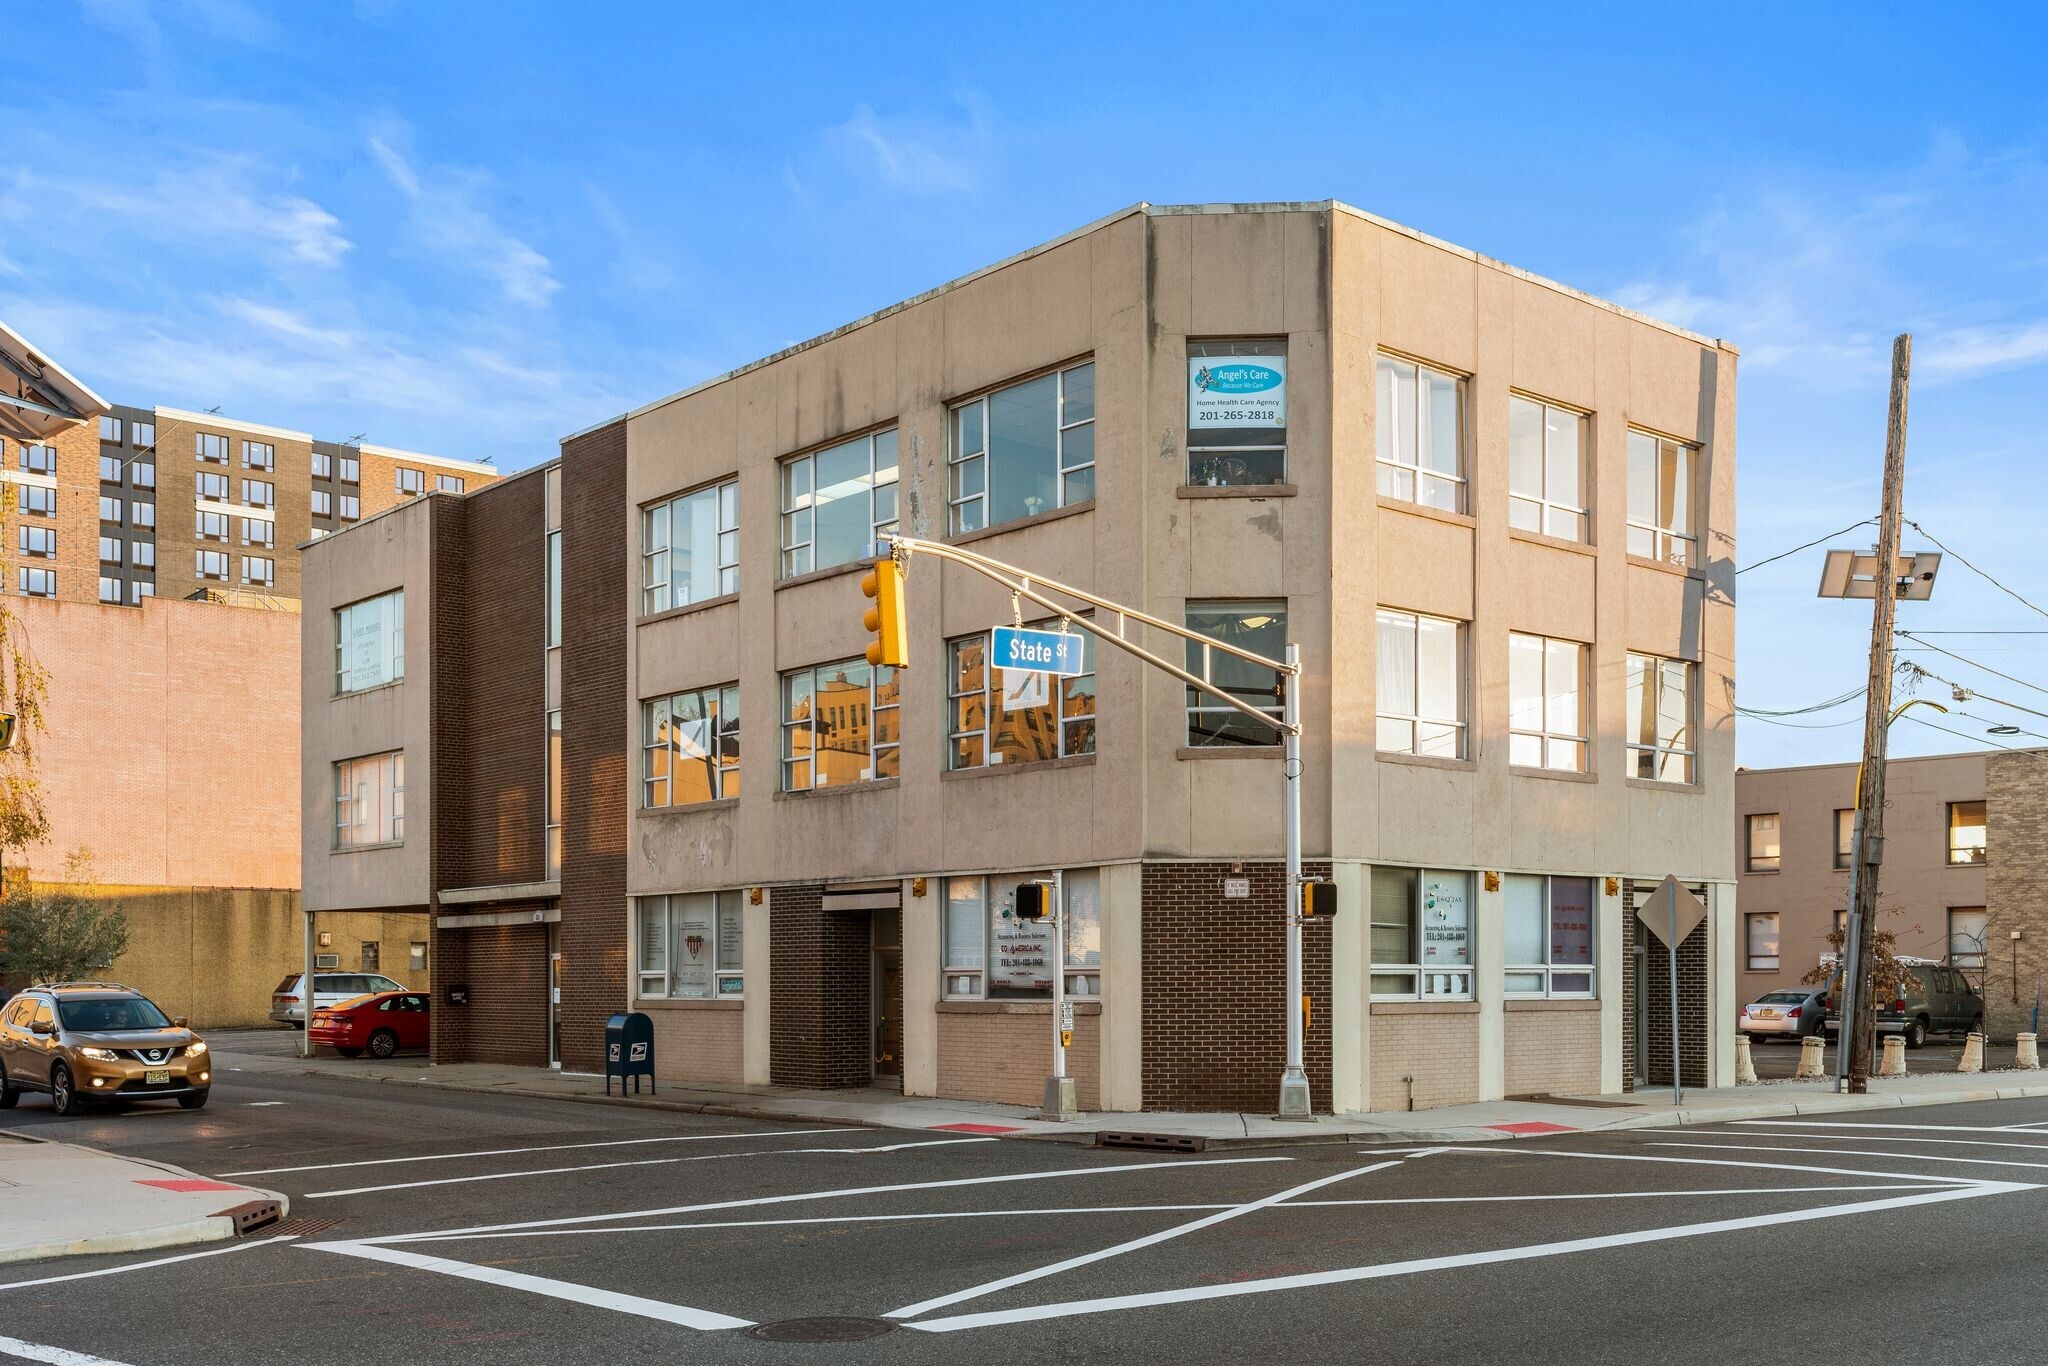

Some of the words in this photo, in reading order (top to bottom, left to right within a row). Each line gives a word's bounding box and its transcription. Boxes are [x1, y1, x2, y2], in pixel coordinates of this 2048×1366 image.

[1217, 369, 1248, 381] Angel's
[1249, 369, 1269, 380] Care
[1256, 399, 1280, 407] Agency
[1199, 410, 1275, 421] 201-265-2818
[1009, 638, 1052, 663] State
[1056, 643, 1068, 658] St
[1000, 958, 1011, 967] TEL:
